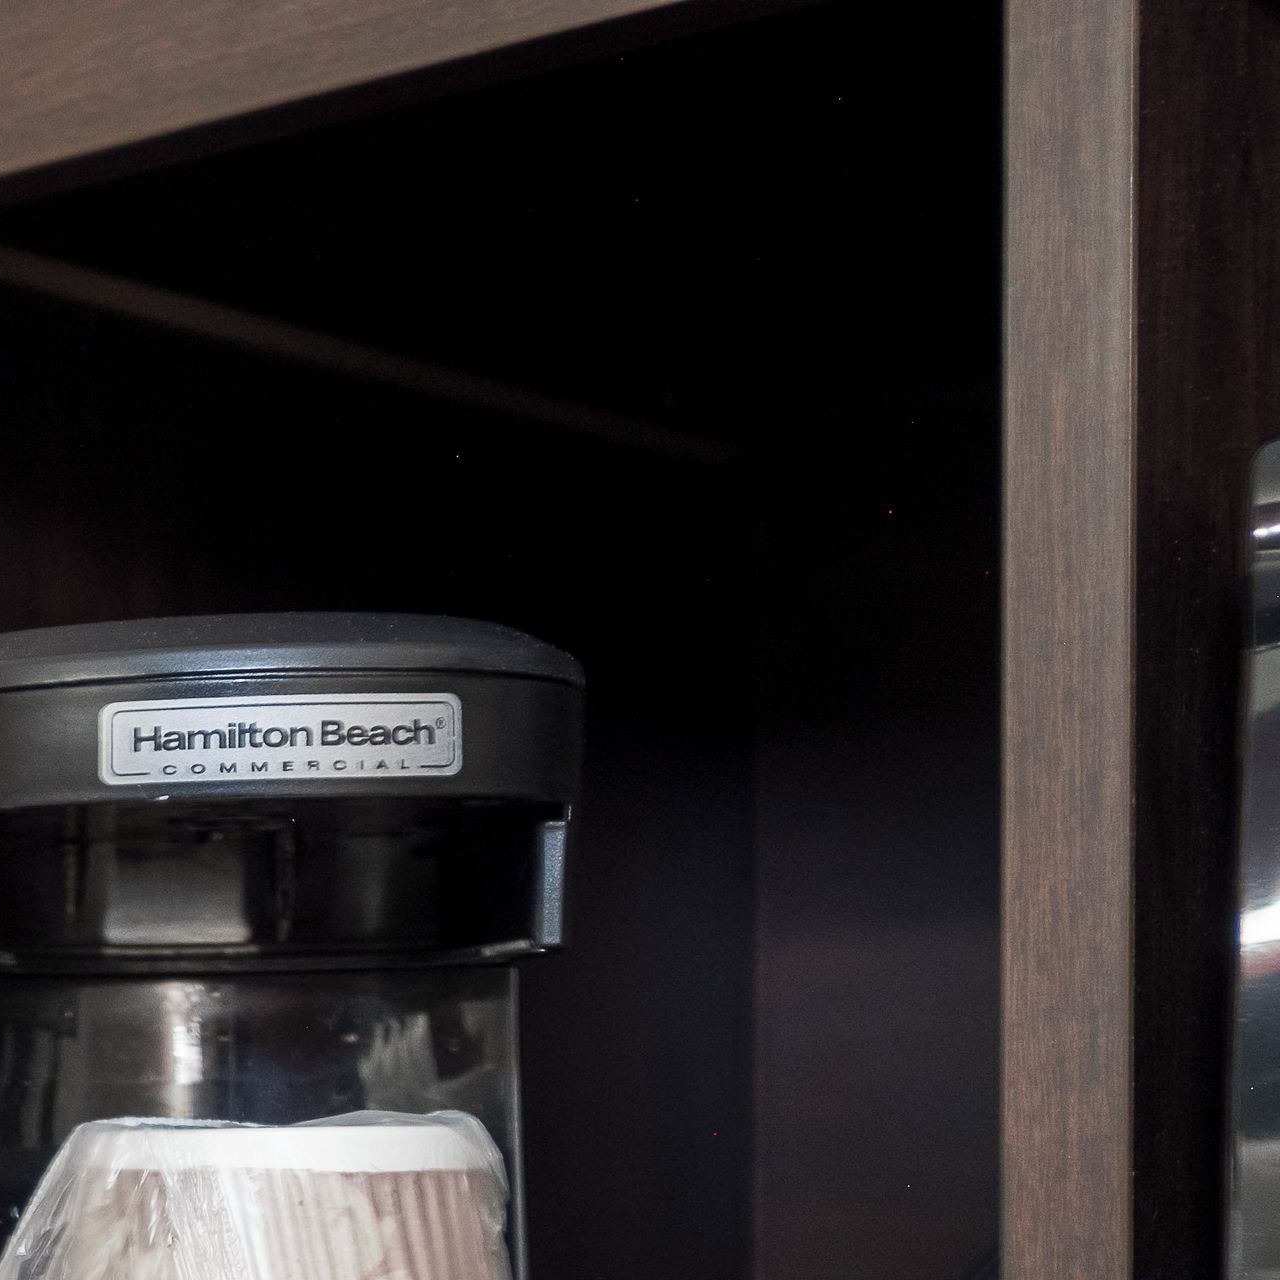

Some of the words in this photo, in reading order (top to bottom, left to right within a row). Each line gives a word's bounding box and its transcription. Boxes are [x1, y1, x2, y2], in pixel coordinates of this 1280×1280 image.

[133, 721, 314, 752] Hamilton
[321, 719, 436, 746] Beach
[163, 759, 410, 775] COMMERCIAL
